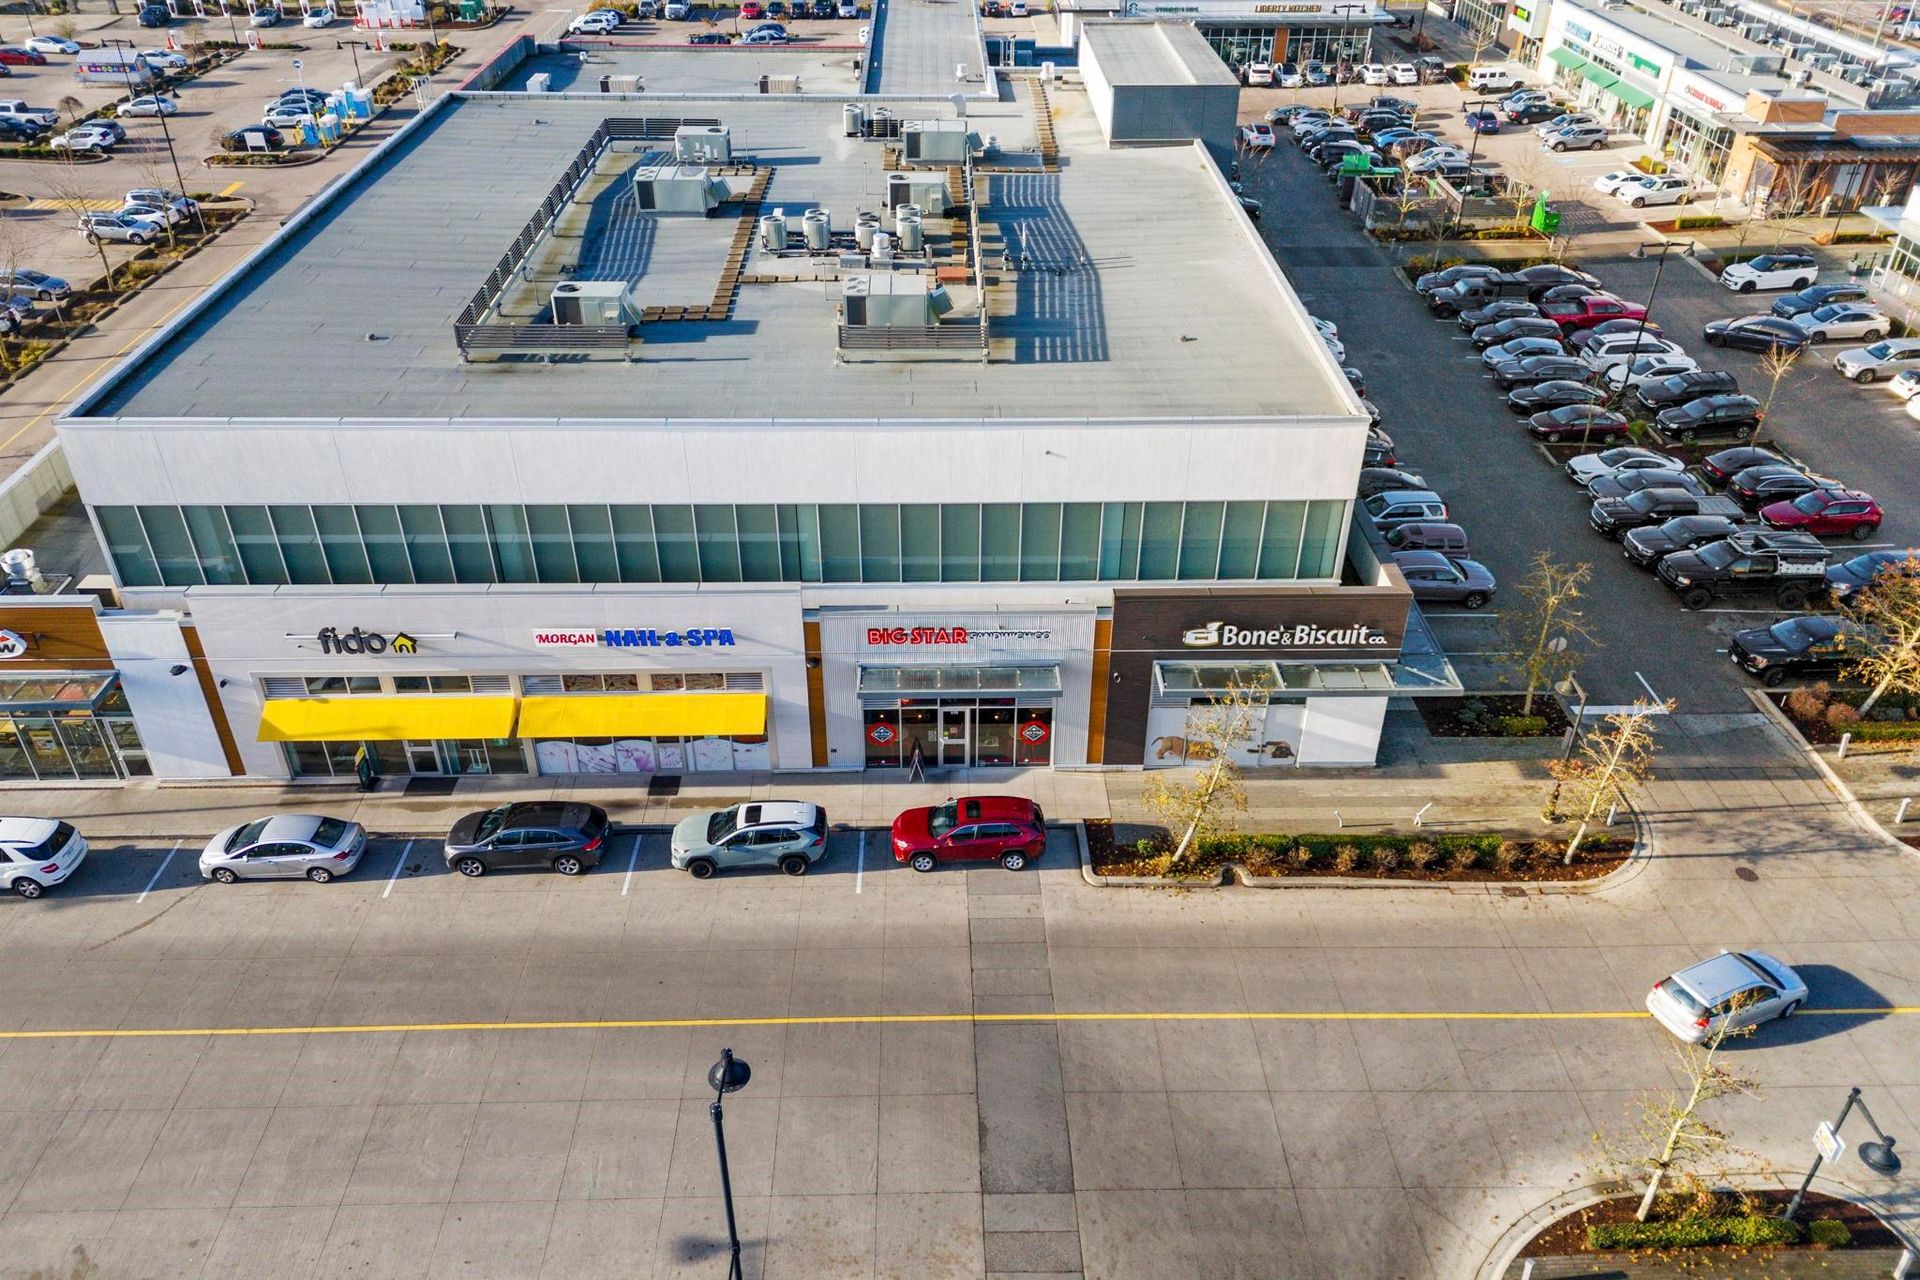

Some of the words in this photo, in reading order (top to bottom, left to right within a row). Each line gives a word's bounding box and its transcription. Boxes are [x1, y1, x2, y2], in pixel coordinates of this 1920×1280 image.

[317, 626, 387, 655] fido
[535, 633, 595, 646] MORGAN
[604, 628, 661, 647] NAIL
[665, 630, 684, 647] &
[686, 627, 736, 647] SPA
[867, 627, 907, 645] BIG
[910, 626, 968, 645] STAR
[1222, 624, 1279, 646] Bone
[1280, 632, 1292, 646] &
[1293, 623, 1370, 646] Biscuit
